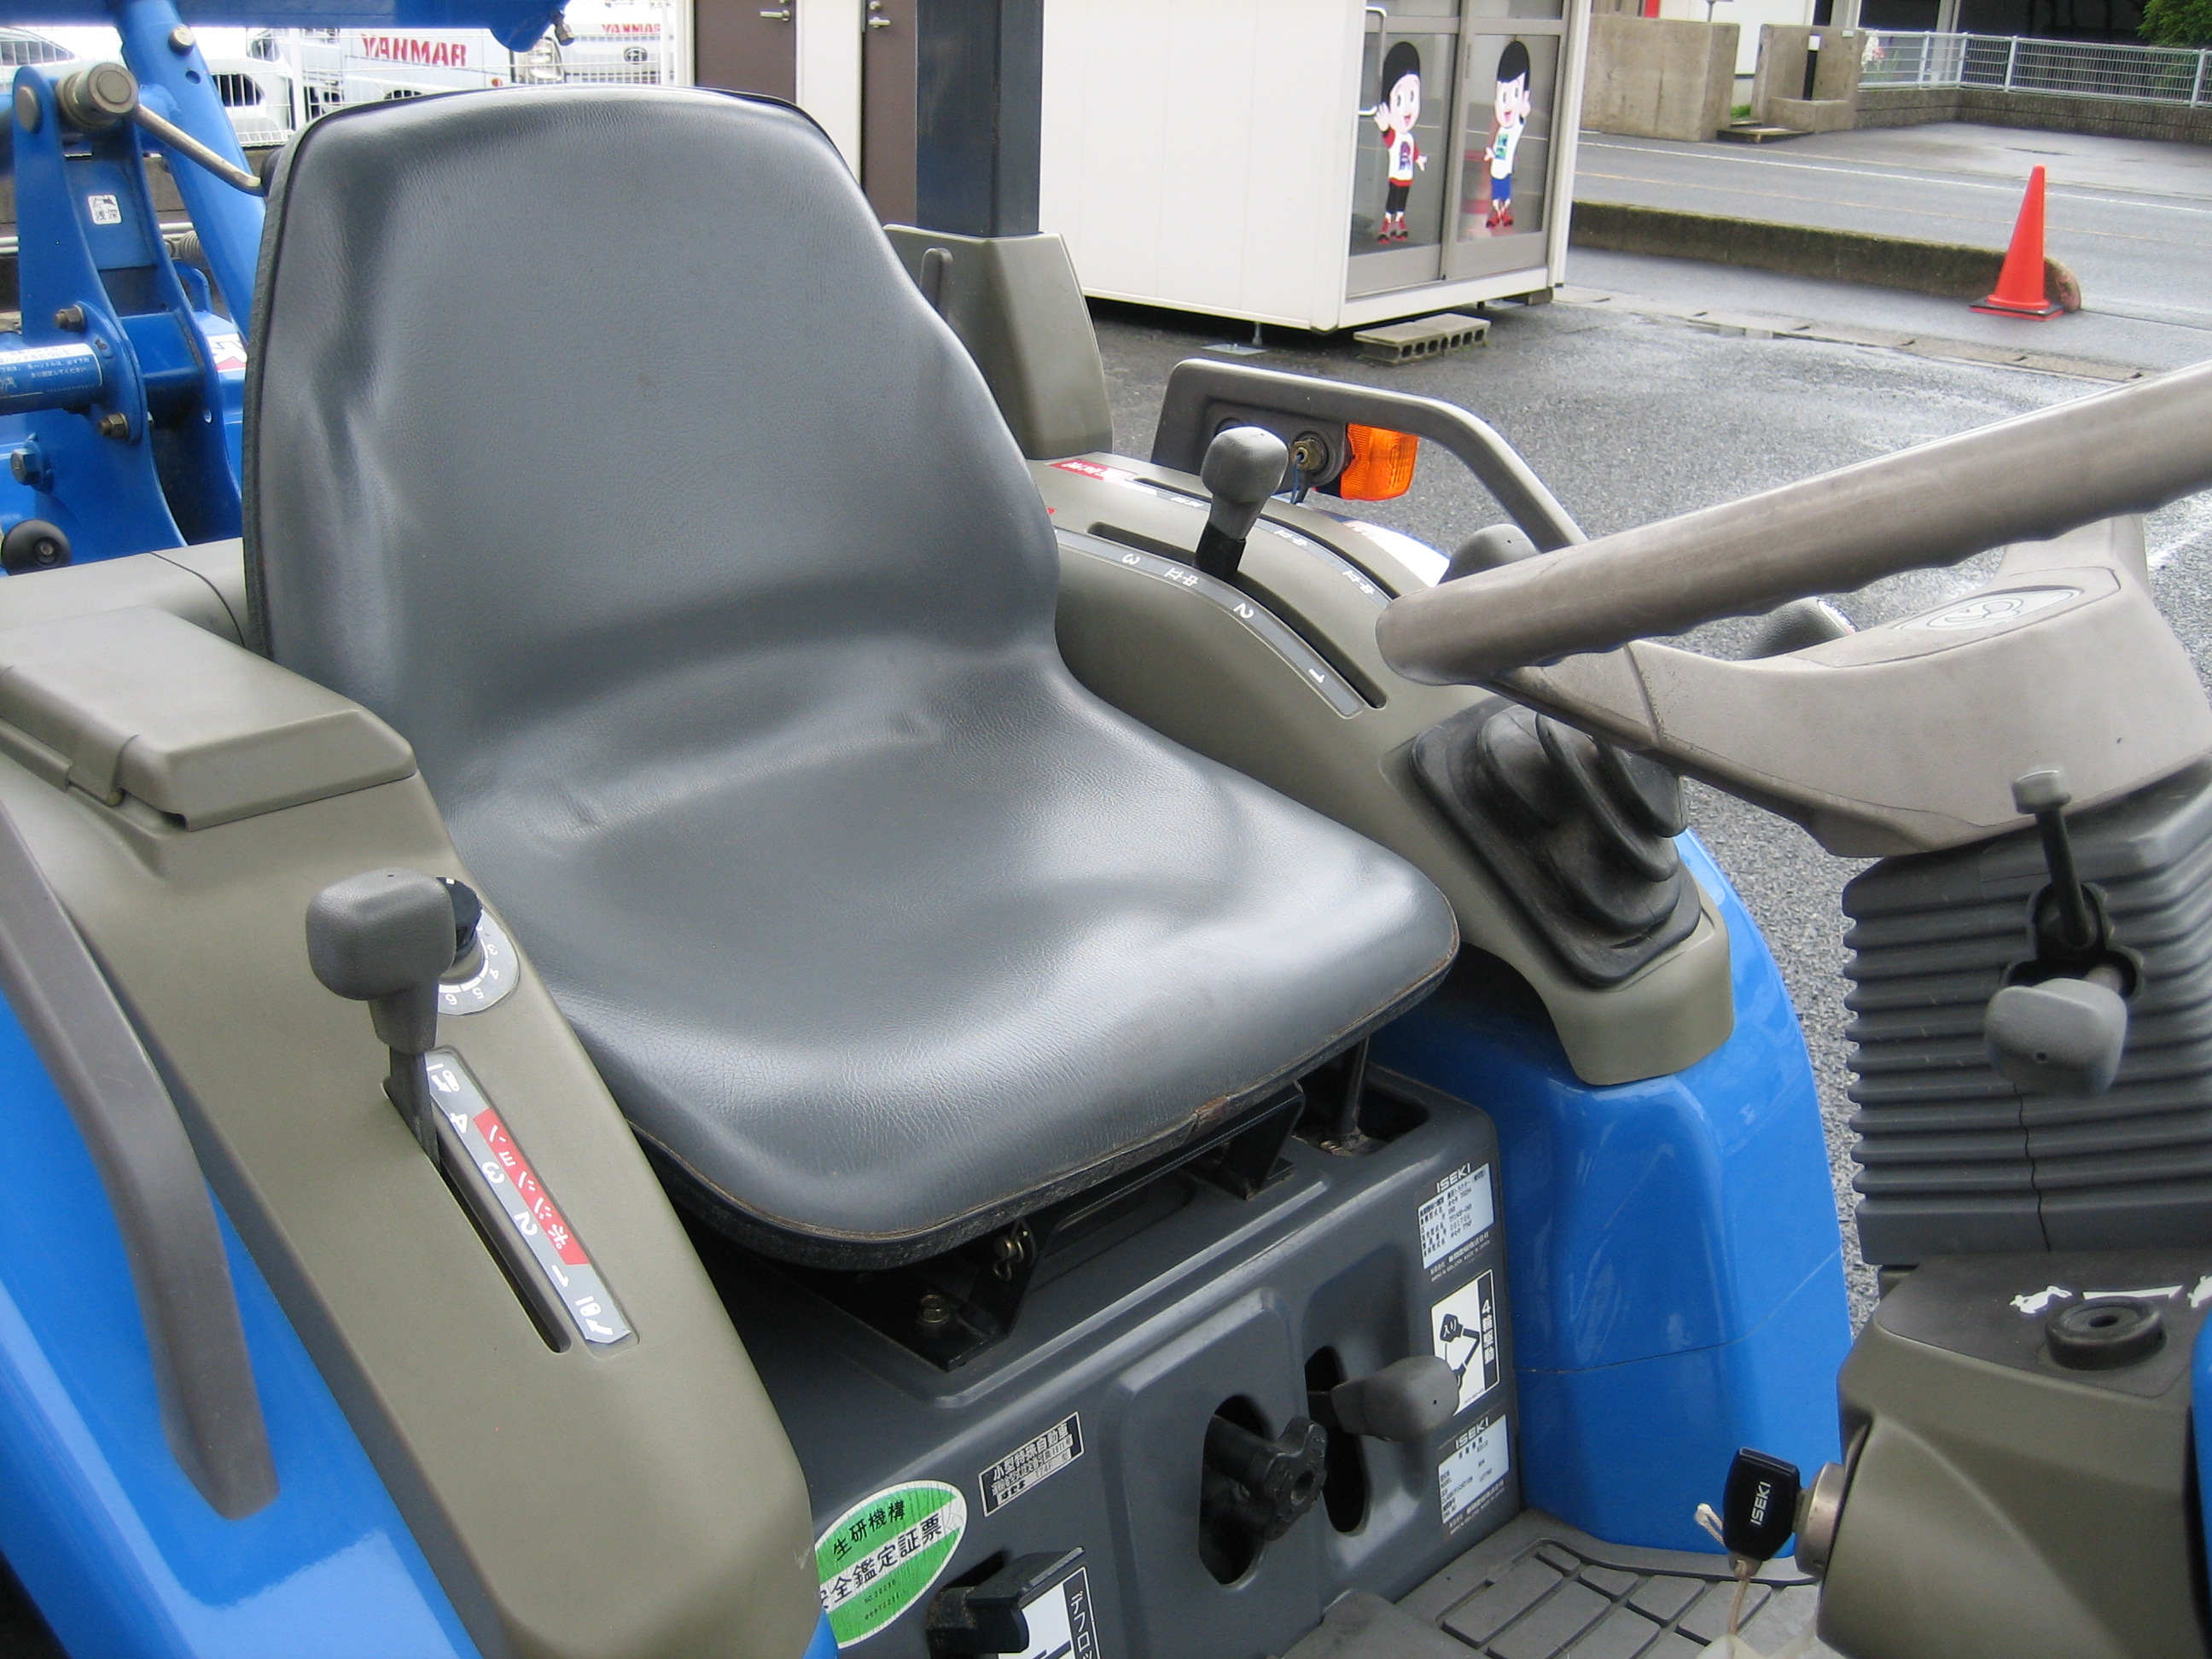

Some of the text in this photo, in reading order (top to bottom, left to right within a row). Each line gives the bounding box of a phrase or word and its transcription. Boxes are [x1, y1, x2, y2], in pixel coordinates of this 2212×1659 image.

[361, 34, 467, 67] YANMAR
[1121, 553, 1141, 565] 3
[1233, 602, 1254, 619] 2
[1307, 668, 1325, 684] 1
[486, 943, 498, 955] 3
[489, 968, 499, 980] 4
[445, 993, 457, 1005] 6
[472, 987, 485, 999] 5
[449, 1112, 469, 1133] 4
[481, 1161, 505, 1185] 3
[1436, 1162, 1471, 1194] ISEKI
[488, 1125, 568, 1249] ポジション
[513, 1211, 538, 1237] 2
[551, 1264, 569, 1288] 1
[1454, 1417, 1489, 1450] ISEKI
[992, 1423, 1068, 1481] 小型特殊自動車
[1749, 1481, 1772, 1526] ISEKI
[833, 1500, 905, 1562] 生研機構
